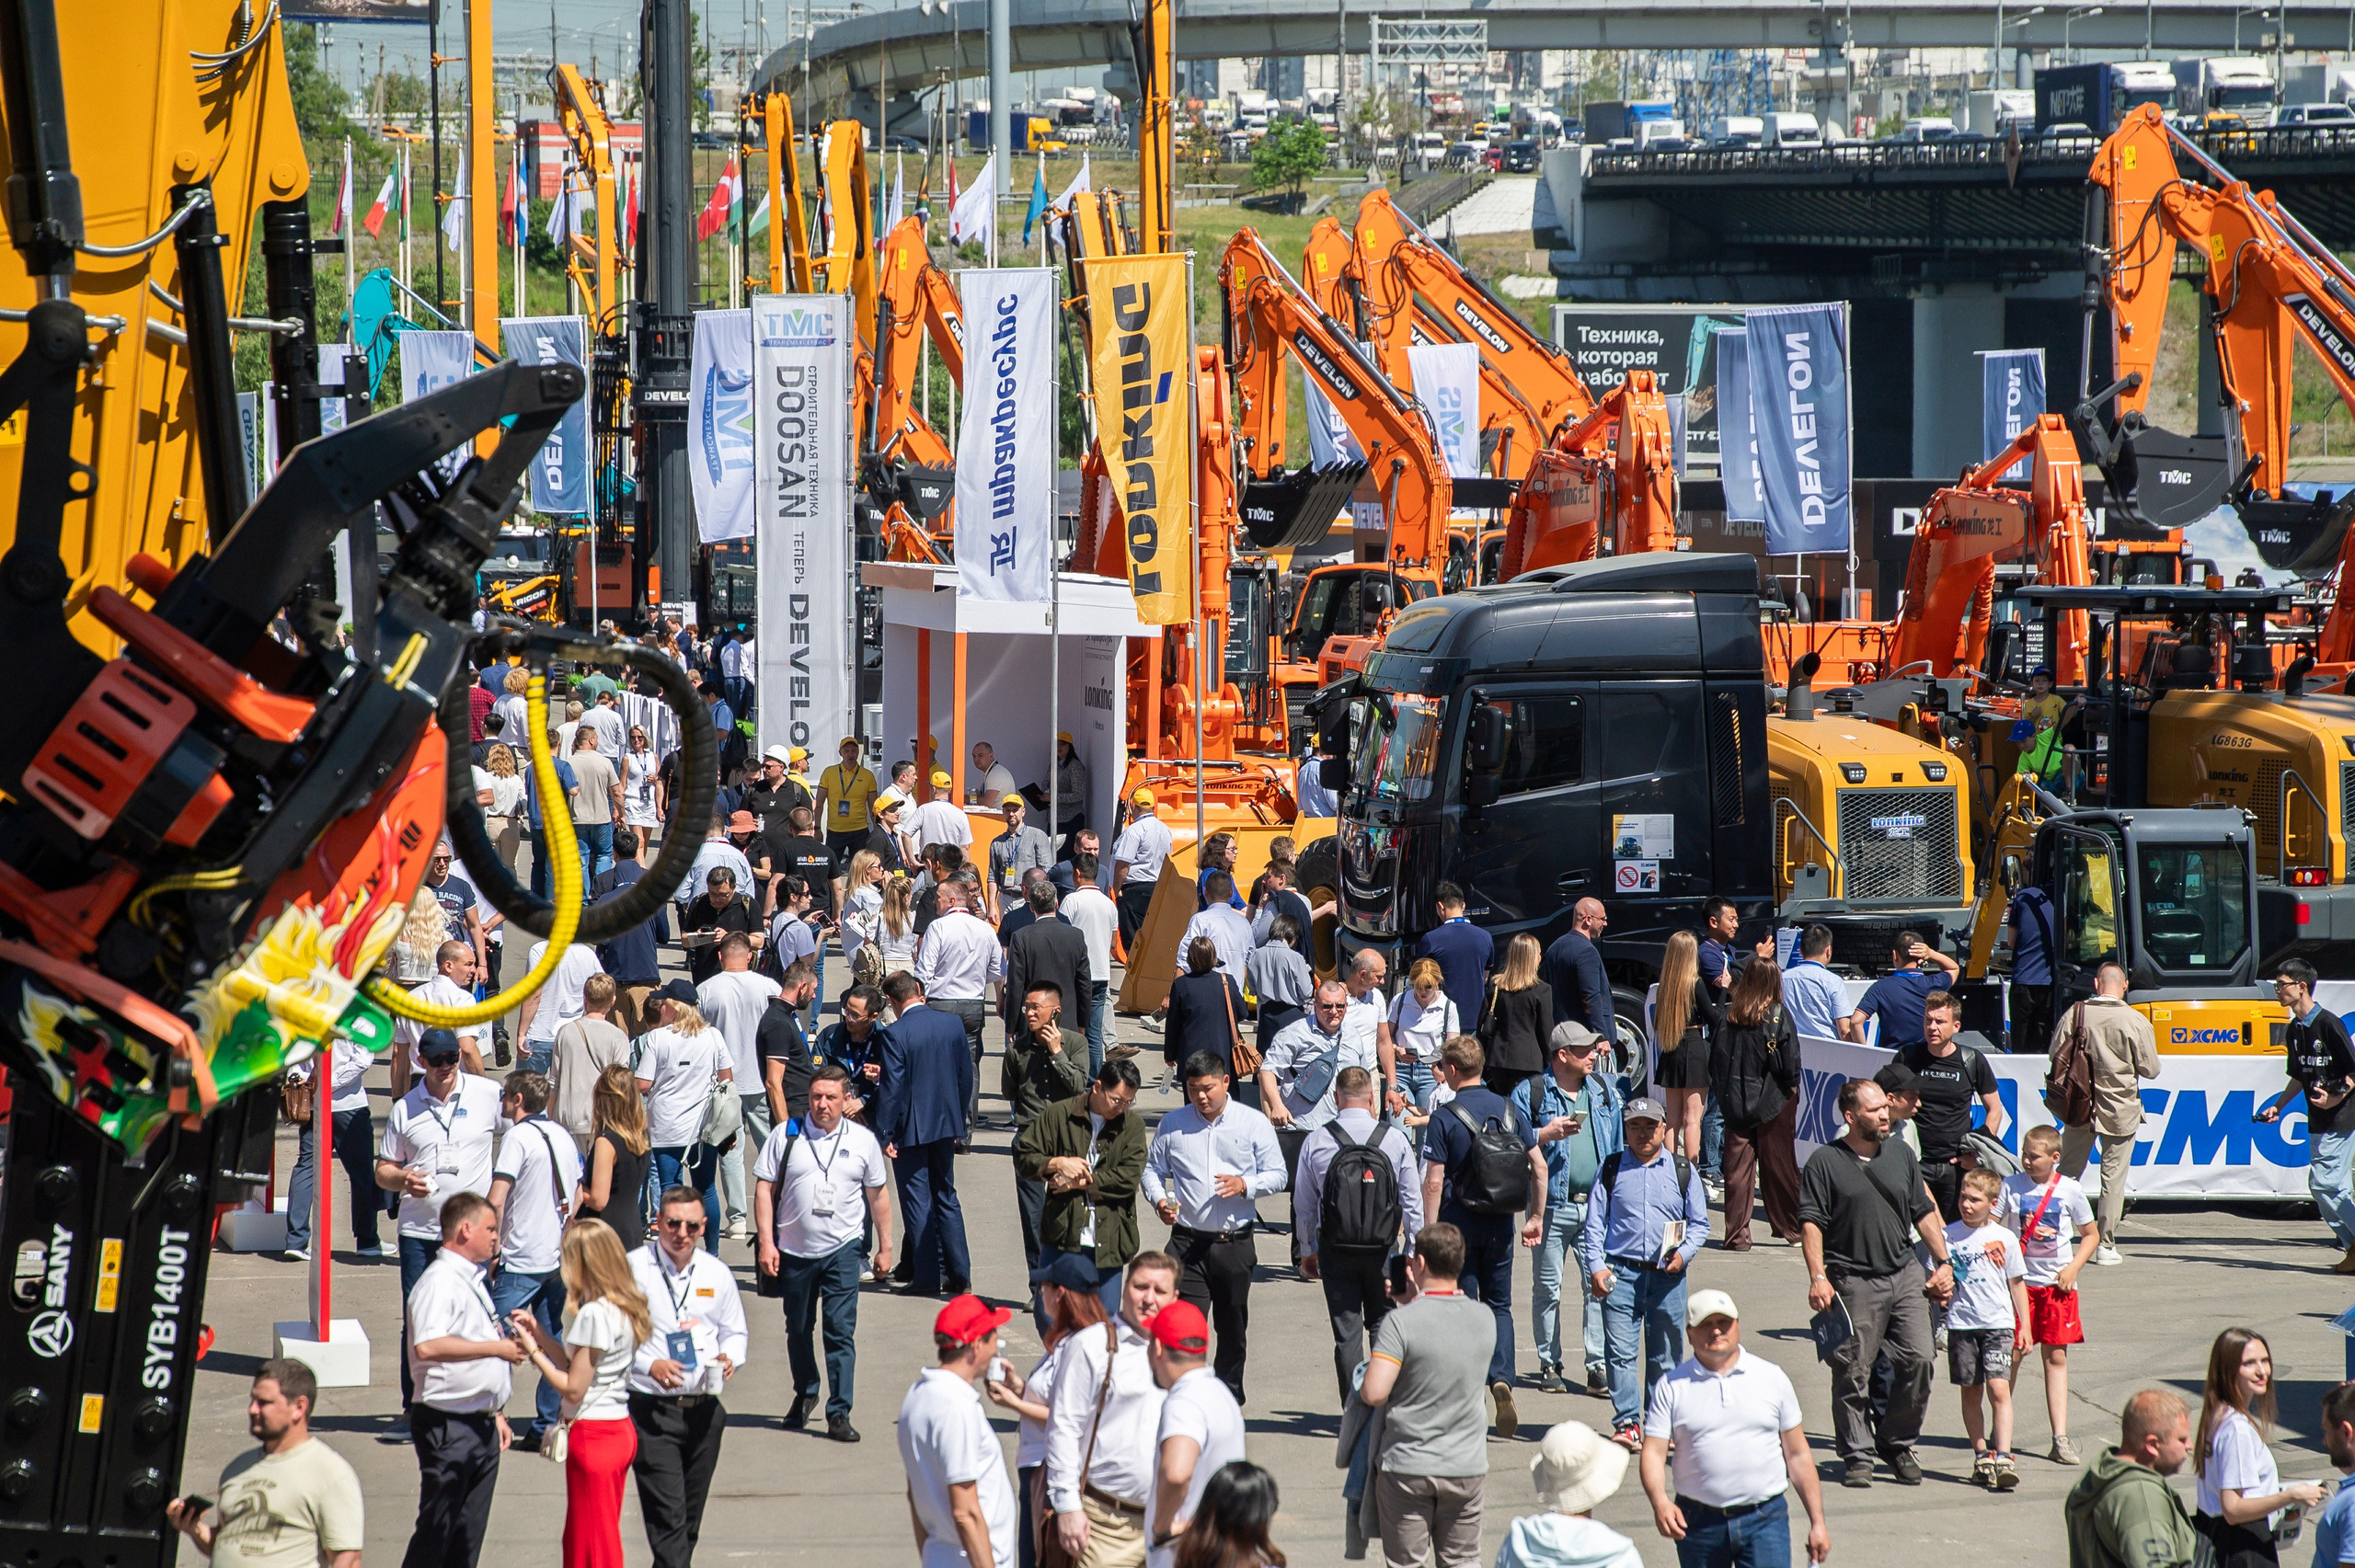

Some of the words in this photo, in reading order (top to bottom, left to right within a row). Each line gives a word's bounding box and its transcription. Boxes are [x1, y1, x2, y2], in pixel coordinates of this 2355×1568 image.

[1456, 303, 1509, 353] DEVELON
[1578, 326, 1664, 347] Техника,
[1296, 334, 1355, 399] DEVELON
[1578, 349, 1659, 368] которая
[1578, 369, 1670, 387] рабоет
[645, 391, 691, 401] DEVEL
[808, 365, 819, 460] СТРОИТЕЛЬНАЯ
[776, 366, 807, 518] DOOSAN
[809, 463, 819, 518] ТЕХНИКА
[793, 531, 805, 584] ТЕПЕРЬ
[1085, 685, 1113, 711] LONKING
[2211, 734, 2253, 748] LG863G
[1871, 815, 1924, 828] LONKING
[2188, 1028, 2240, 1044] XCMG
[2043, 1088, 2311, 1168] CMG
[44, 1222, 74, 1308] SANY
[142, 1223, 190, 1390] SYB1400T
